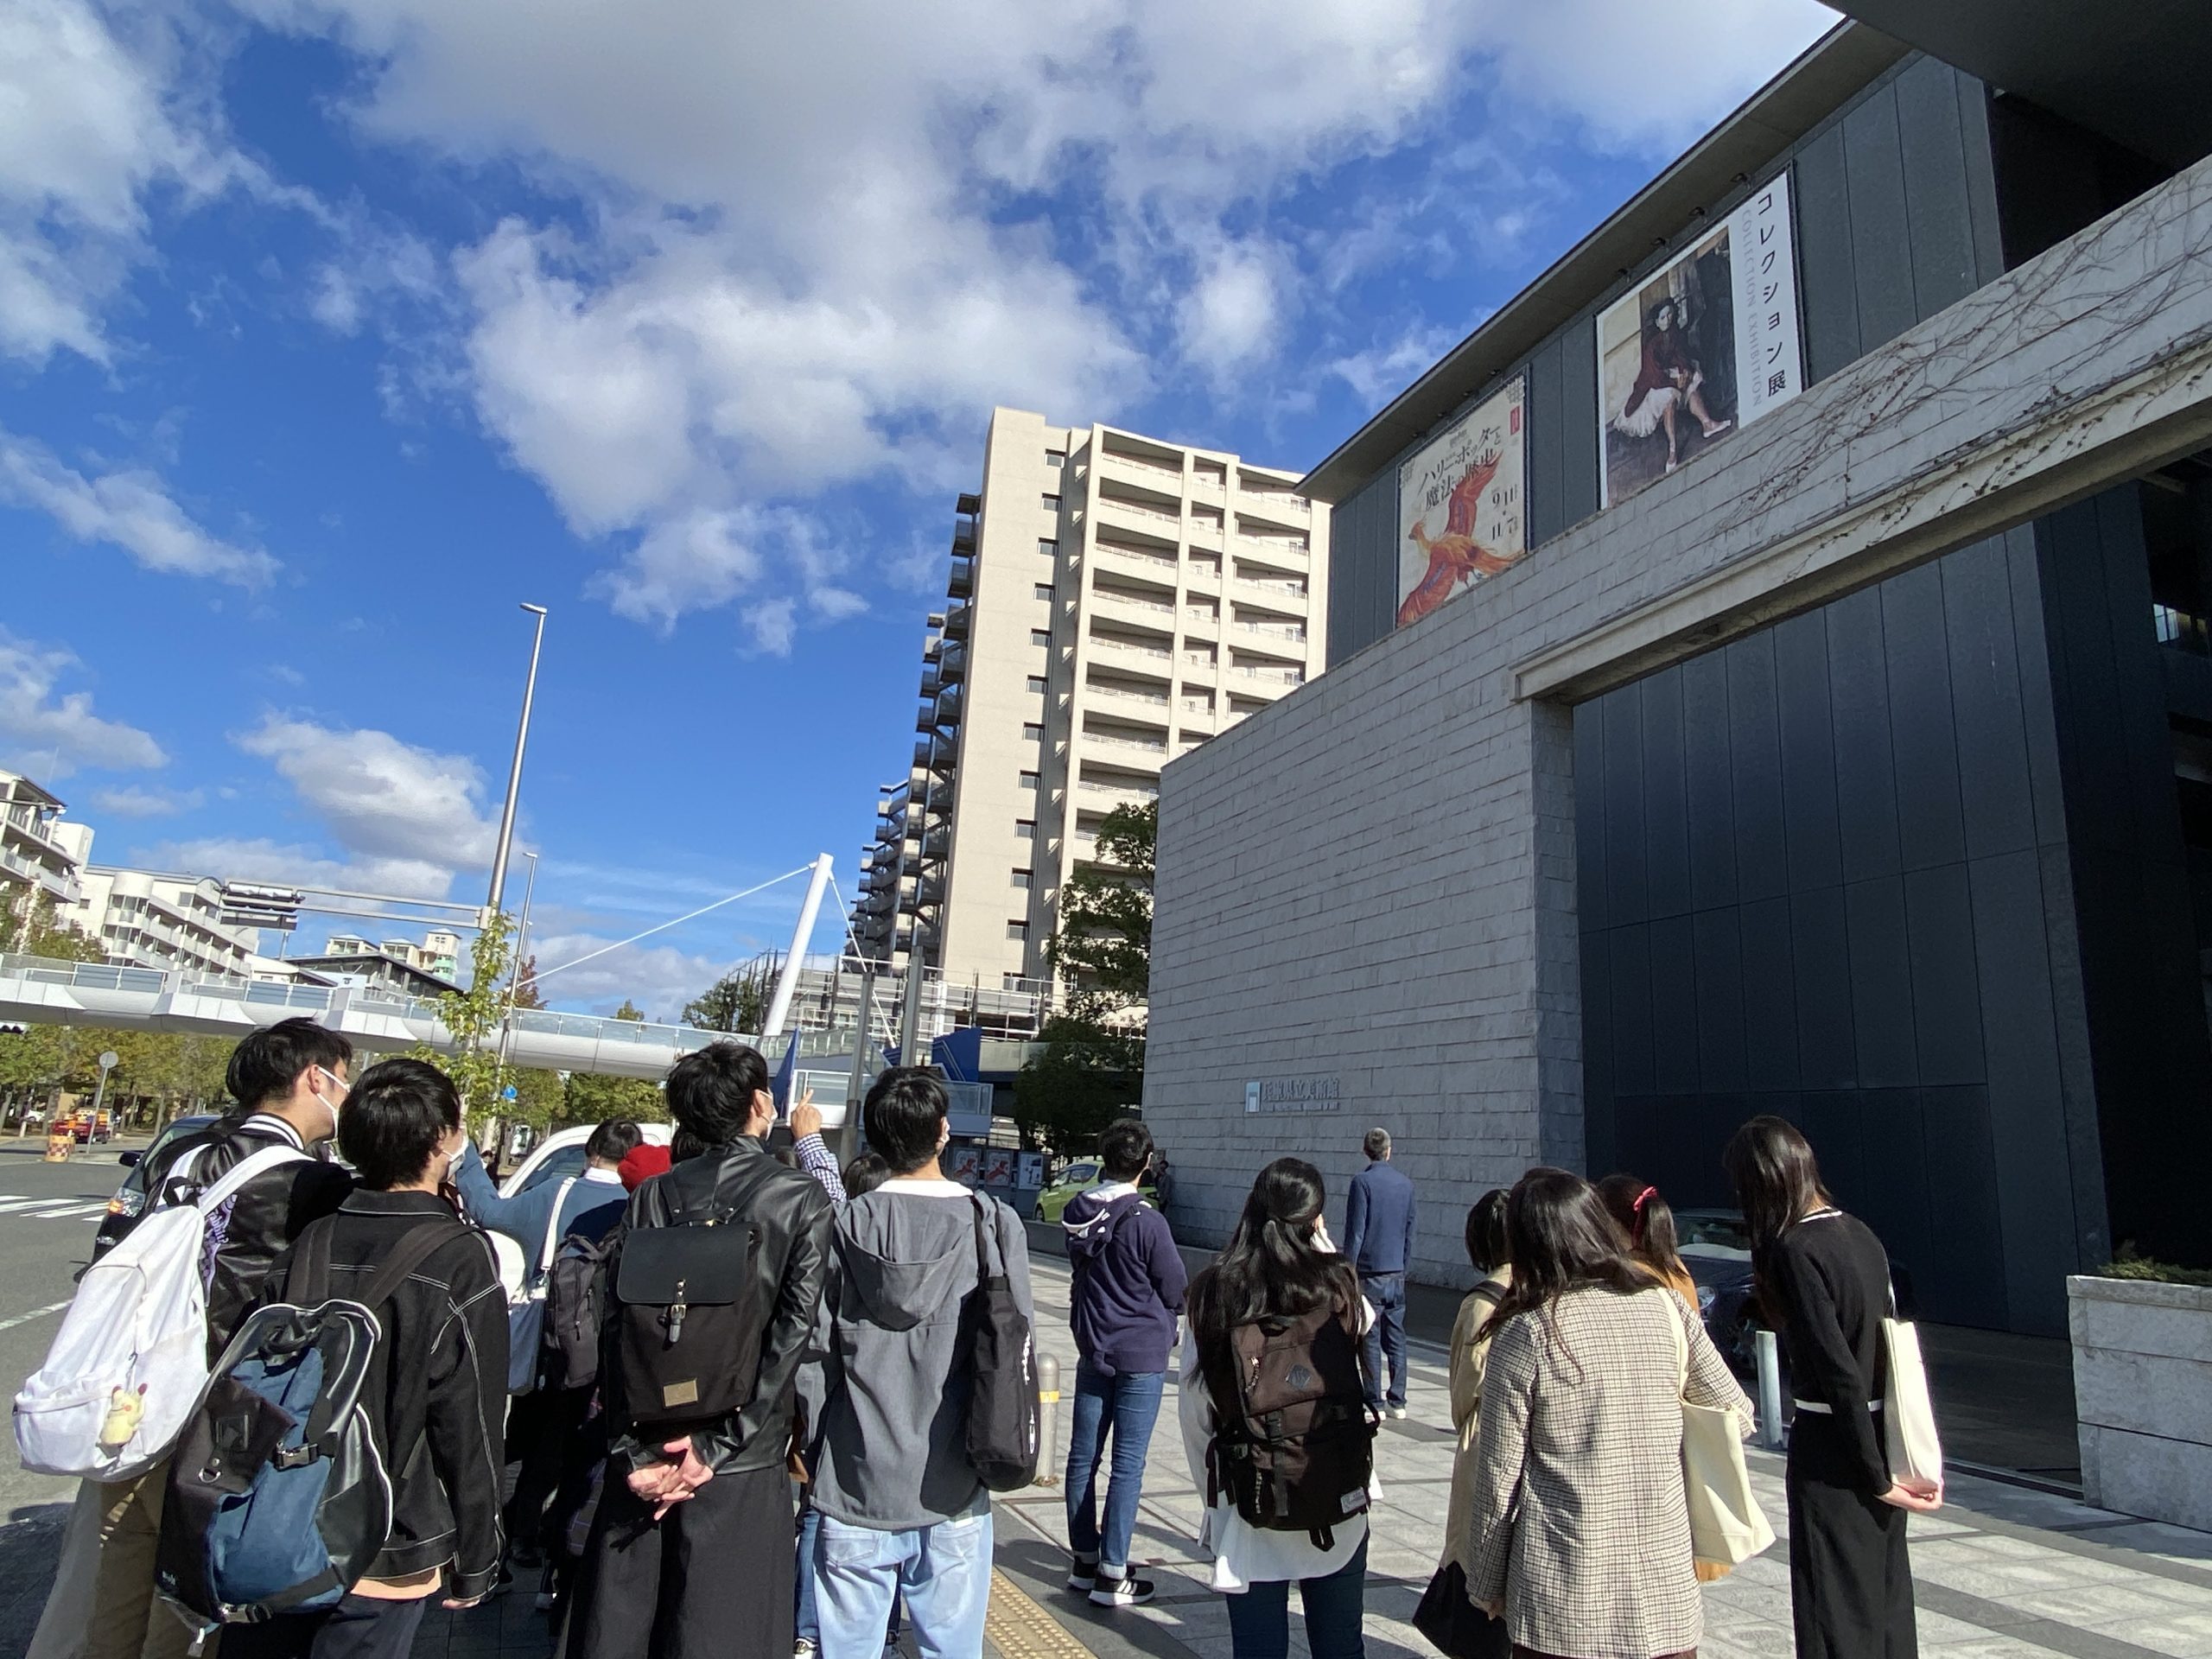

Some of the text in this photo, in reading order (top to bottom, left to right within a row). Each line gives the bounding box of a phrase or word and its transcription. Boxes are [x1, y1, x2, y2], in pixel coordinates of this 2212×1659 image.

[1742, 209, 1763, 407] COLLECTION EXHIBITION
[1758, 192, 1787, 398] コレクション展
